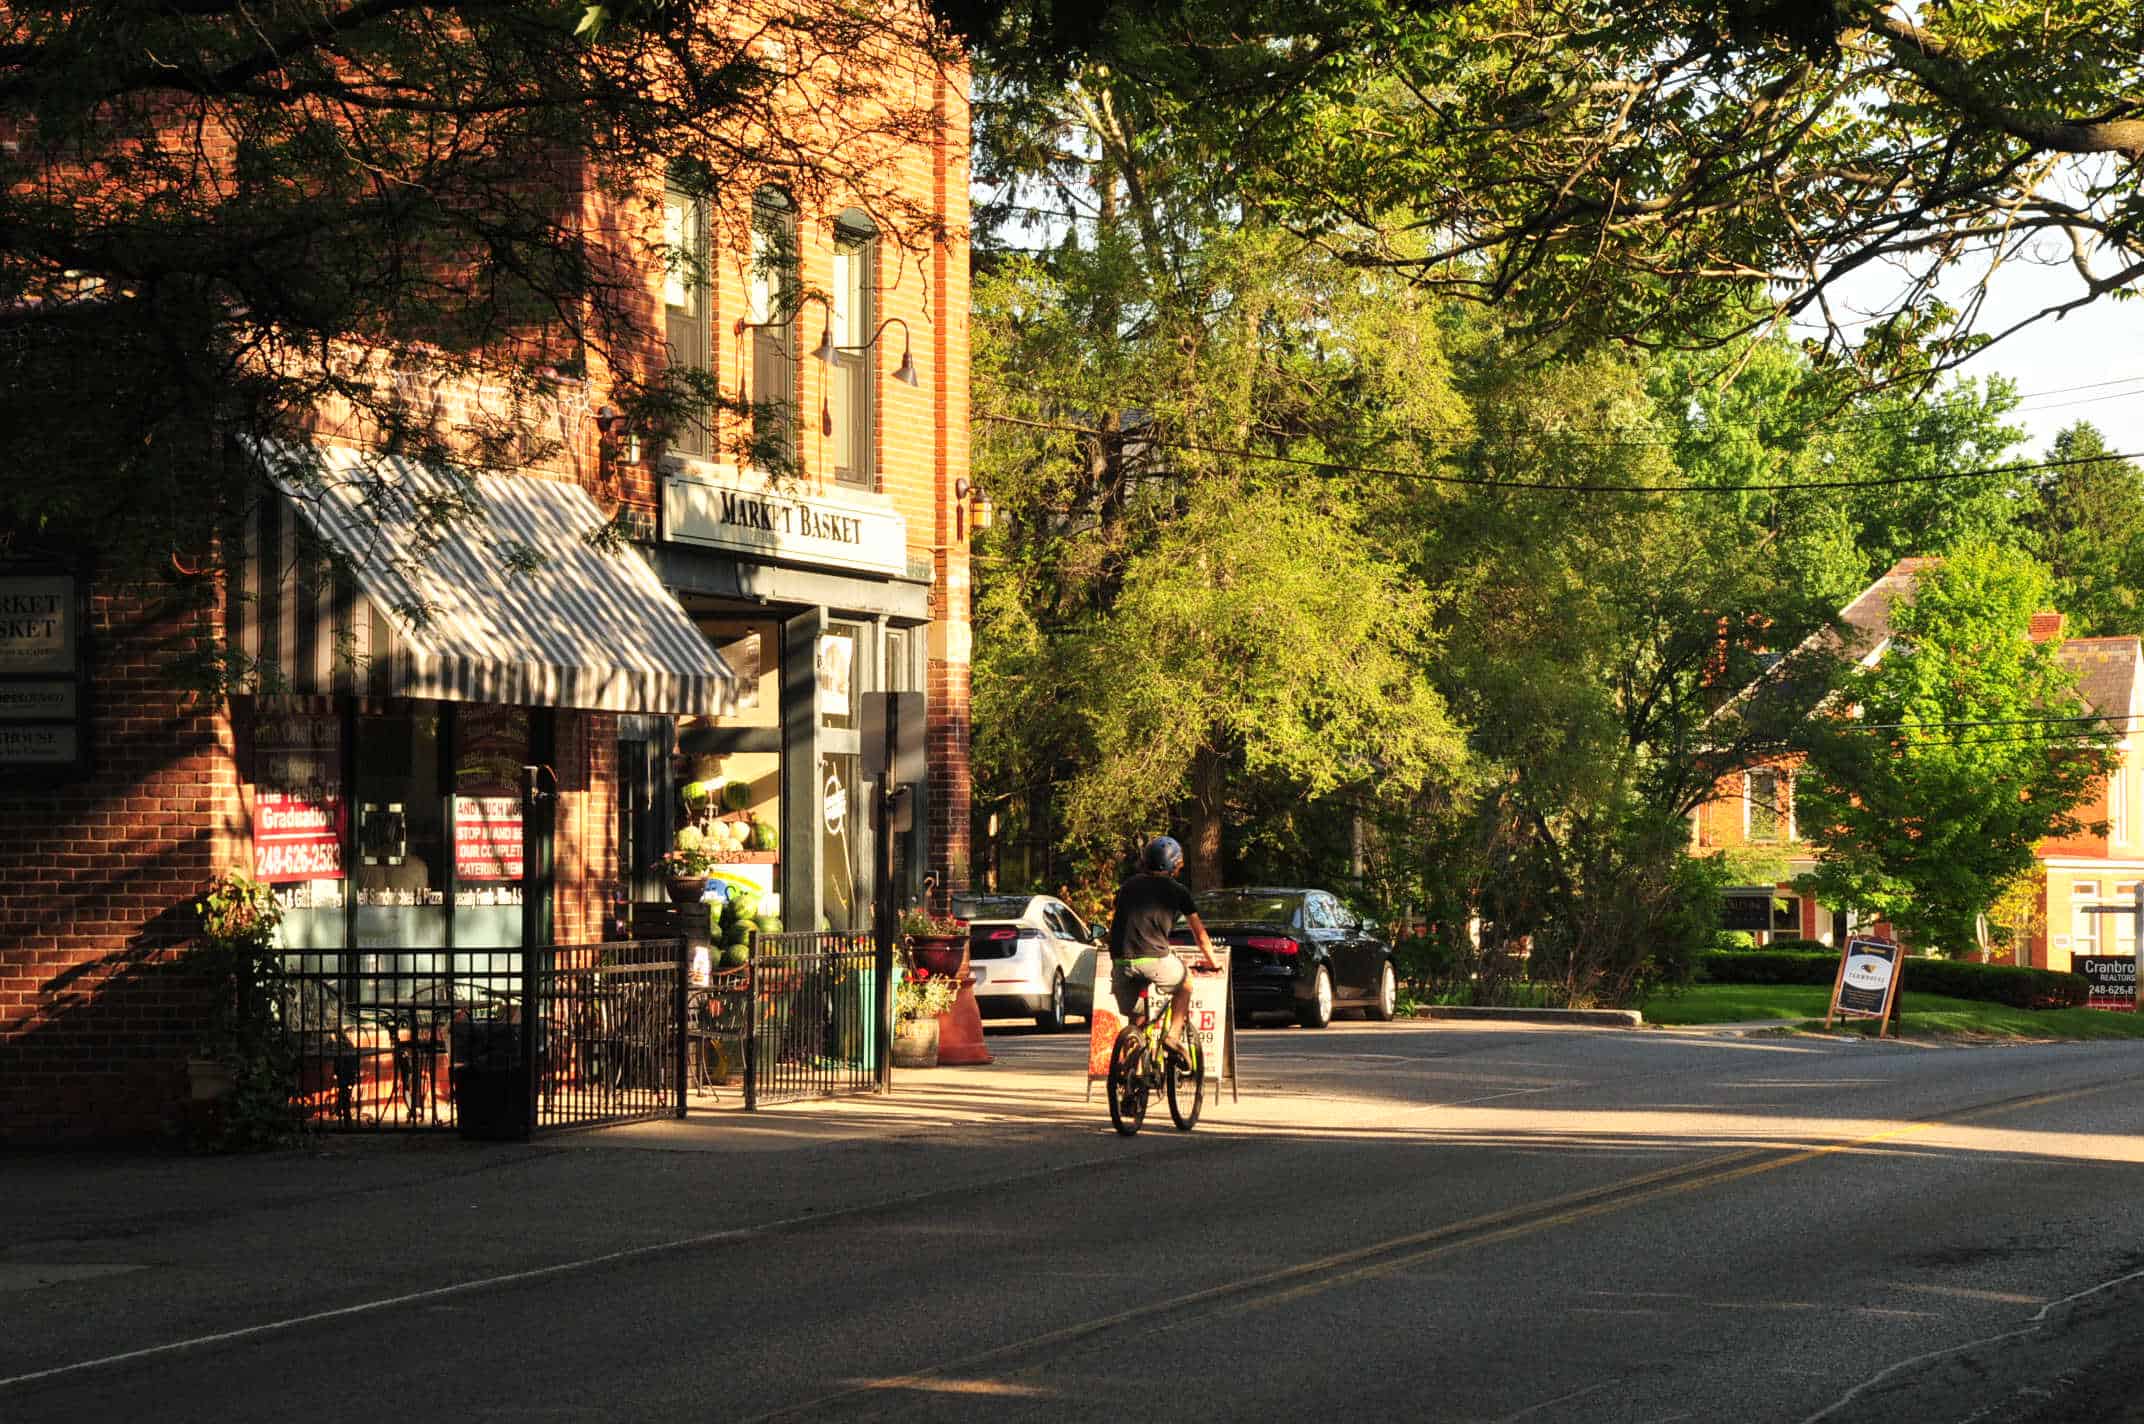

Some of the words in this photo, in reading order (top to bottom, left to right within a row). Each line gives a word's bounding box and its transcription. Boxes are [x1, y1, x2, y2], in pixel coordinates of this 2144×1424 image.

[720, 491, 793, 534] MARKET
[799, 503, 862, 545] BASKET
[256, 785, 283, 805] The
[287, 782, 322, 804] Taste
[458, 801, 477, 815] AND
[262, 806, 335, 829] Graduation
[457, 826, 481, 841] STOP
[492, 826, 512, 840] AND
[460, 844, 480, 858] OUR
[256, 843, 342, 876] 248-626-2583
[458, 861, 502, 876] CATERING
[2085, 959, 2136, 974] Cranbro
